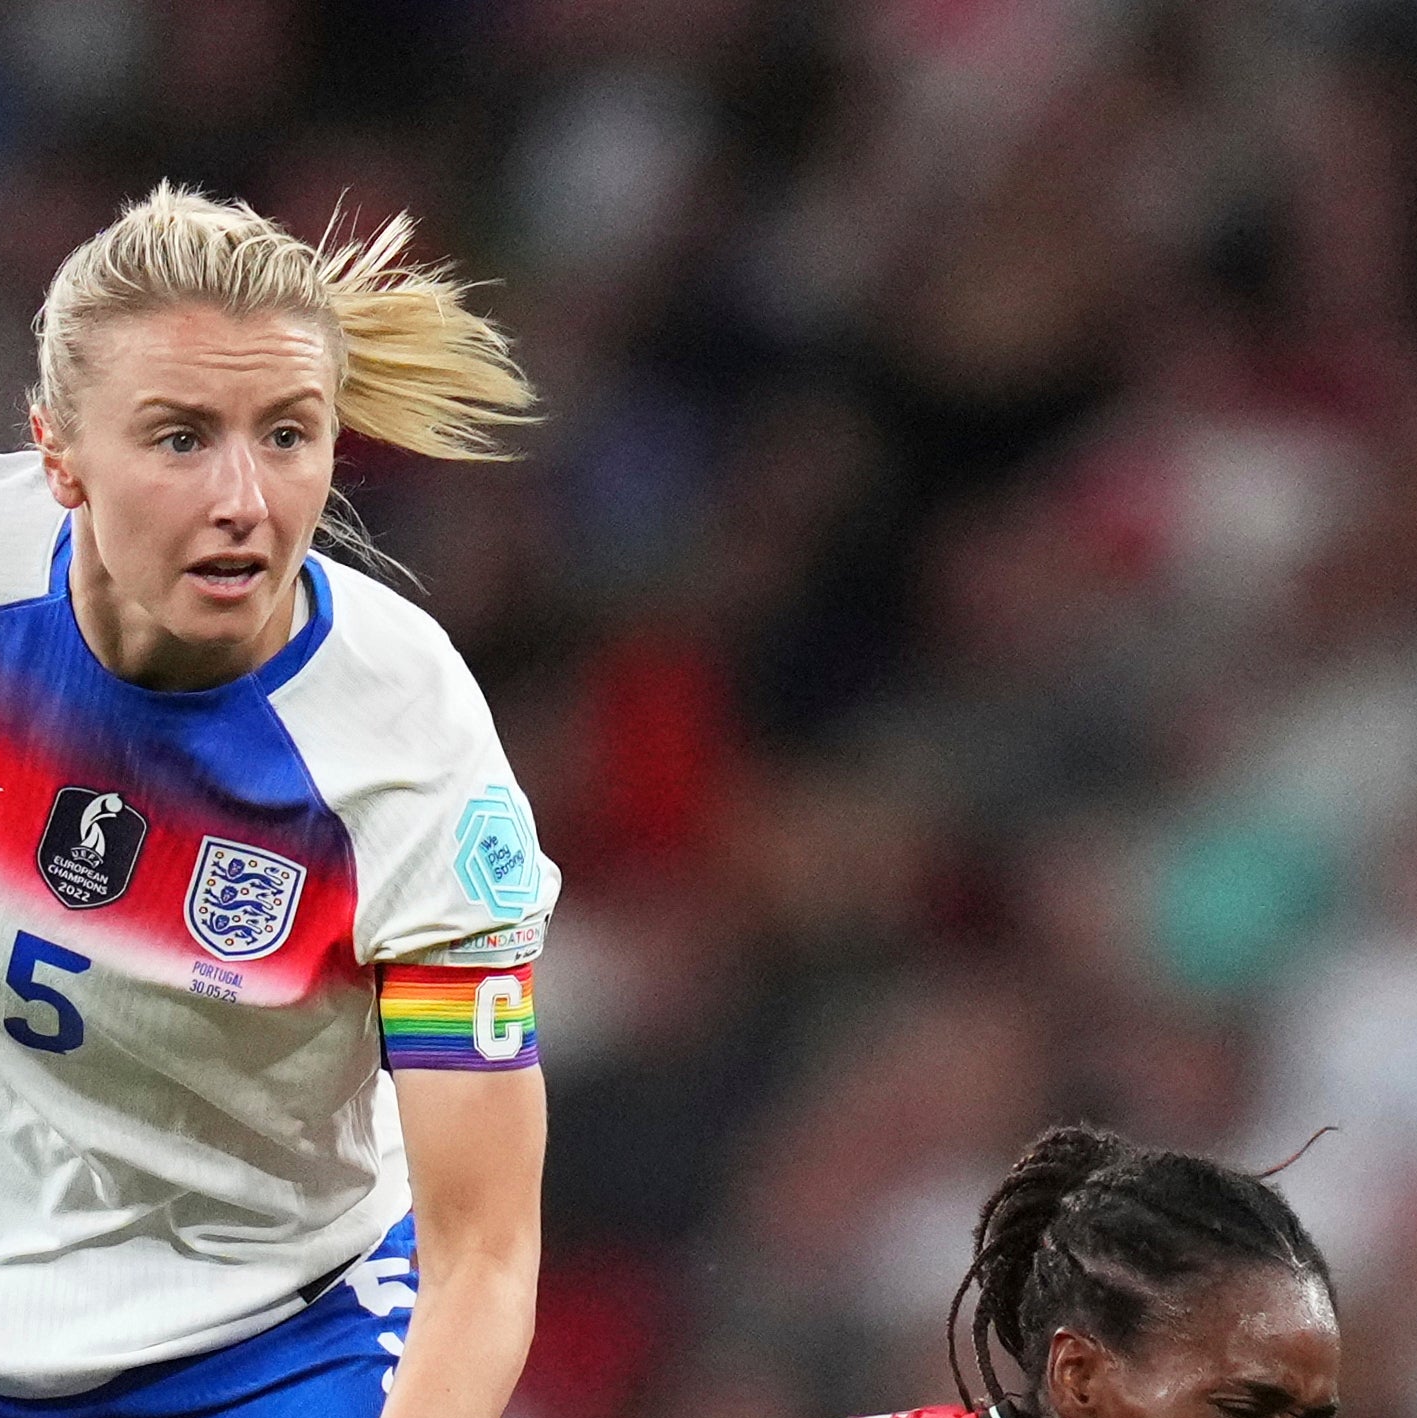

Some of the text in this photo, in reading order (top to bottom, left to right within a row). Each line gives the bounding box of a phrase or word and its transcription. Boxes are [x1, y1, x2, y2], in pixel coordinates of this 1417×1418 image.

[480, 835, 498, 851] We
[488, 844, 511, 865] Play
[53, 855, 109, 884] EUROPEAN
[72, 849, 101, 868] UEFA
[494, 850, 525, 881] Strong
[47, 864, 108, 895] CHAMPIONS
[58, 881, 91, 902] 2022
[192, 961, 243, 989] PORTUGAL
[4, 930, 91, 1055] 5
[473, 975, 522, 1060] C
